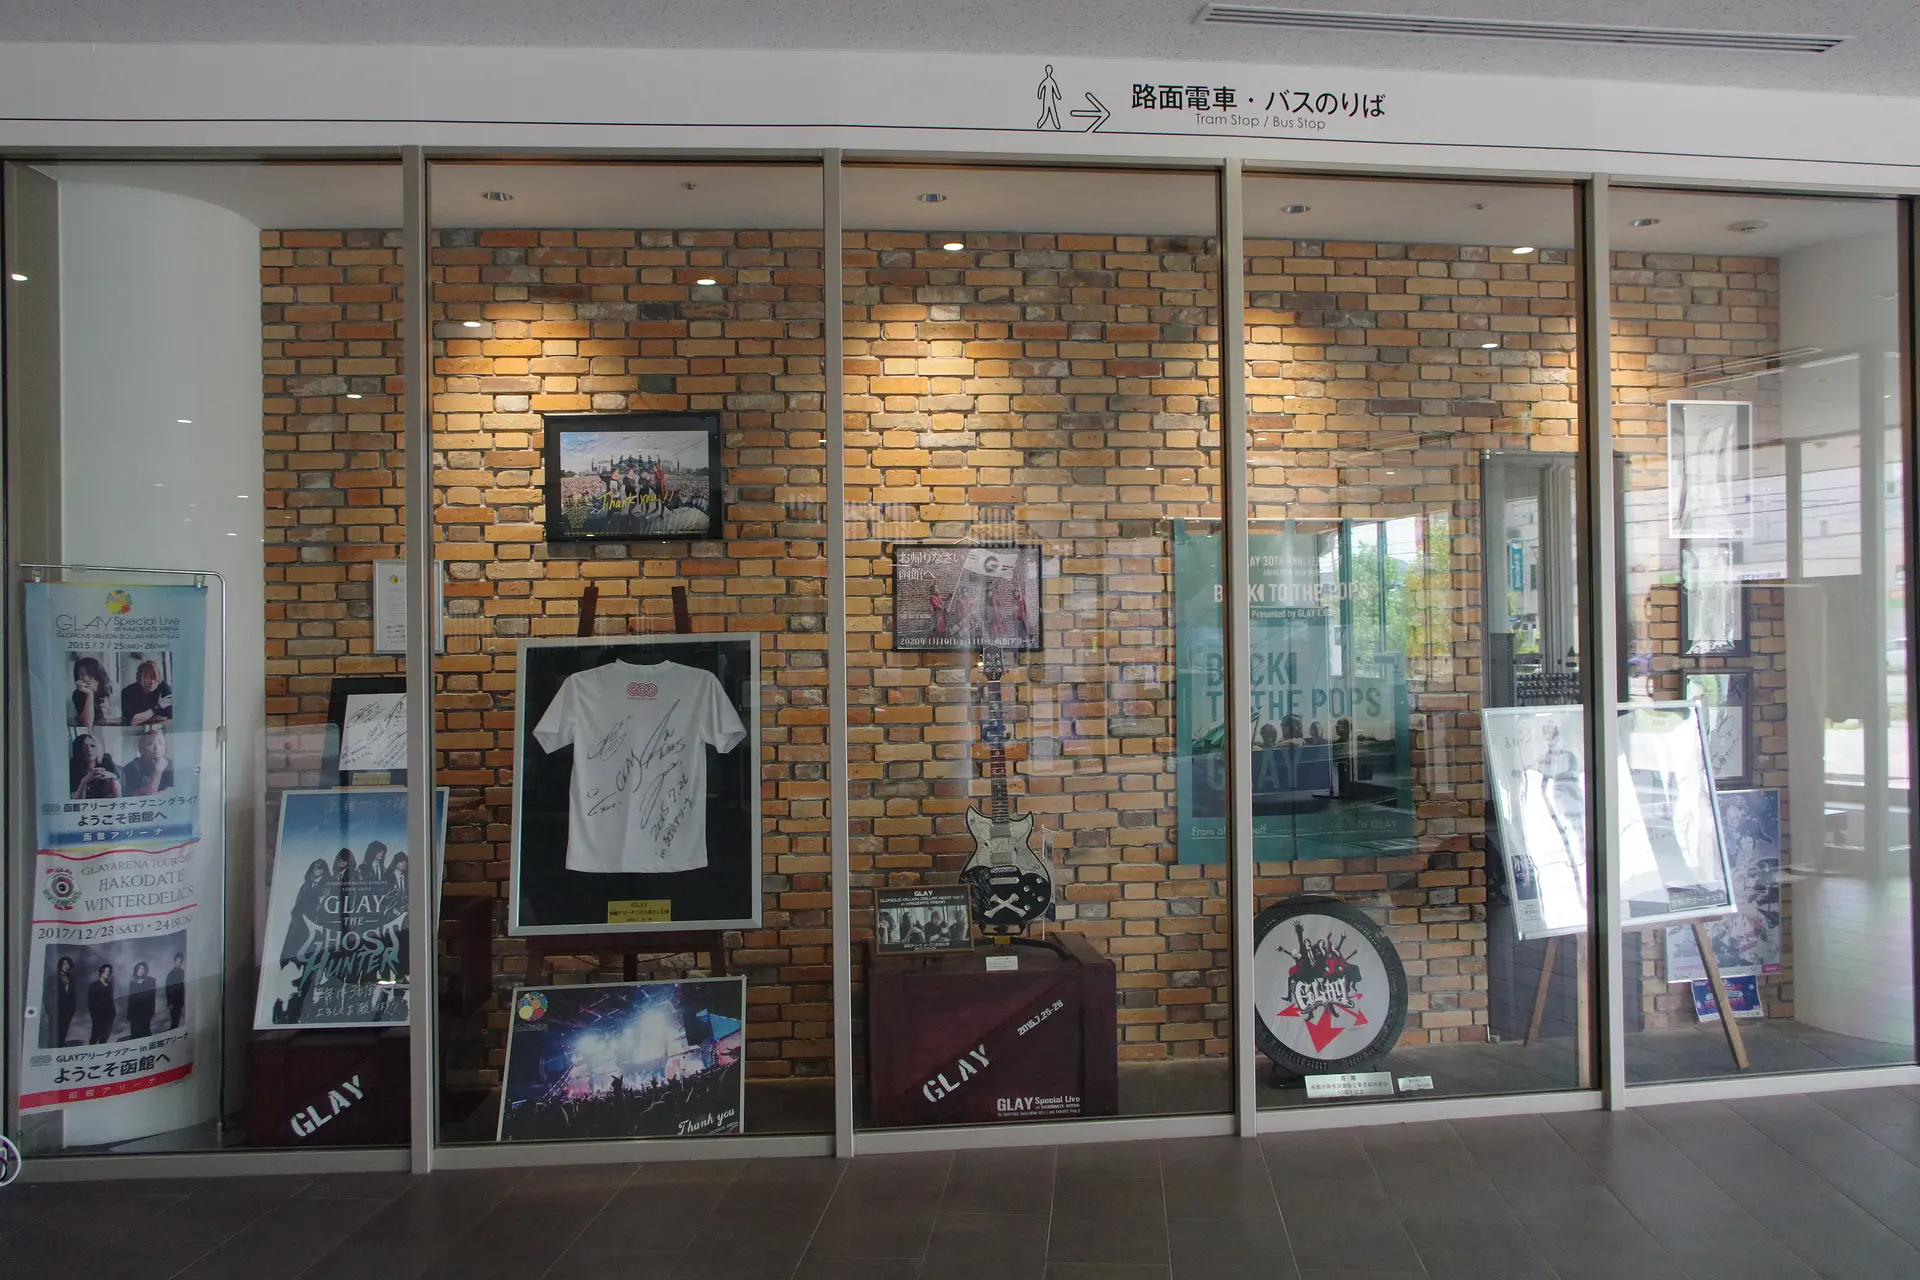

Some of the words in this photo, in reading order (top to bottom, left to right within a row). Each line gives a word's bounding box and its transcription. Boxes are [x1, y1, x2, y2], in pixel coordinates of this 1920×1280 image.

[1131, 83, 1387, 118] 路面電車・バスのりば
[1195, 113, 1228, 125] Tram
[1231, 114, 1260, 127] Stop
[1264, 116, 1270, 128] /
[1273, 116, 1295, 128] Bus
[1297, 117, 1327, 130] Stop
[595, 490, 636, 511] Thank
[898, 551, 966, 565] お帰りなさい
[1263, 556, 1285, 567] 30TH
[898, 567, 936, 581] 函館へ
[1268, 583, 1288, 603] TO
[1292, 583, 1322, 603] THE
[55, 614, 113, 631] GLAY
[113, 615, 157, 628] Special
[159, 615, 180, 626] Live
[1251, 609, 1286, 619] Presented
[1287, 609, 1296, 619] by
[1297, 608, 1316, 618] GLAY
[67, 641, 91, 650] 2015
[1311, 686, 1382, 720] POPS
[1207, 749, 1305, 791] GAY
[77, 811, 168, 827] ようこそ函館へ
[99, 868, 186, 892] HAKODATE
[84, 884, 195, 912] WINTERDELICS
[323, 894, 386, 915] GLAY
[344, 916, 364, 926] THE
[296, 911, 408, 963] GHOST
[300, 946, 400, 990] HUNTER
[56, 1045, 139, 1063] GLAYアリーナツアー
[139, 1044, 148, 1053] in
[53, 1053, 172, 1084] ようこそ函館へ
[922, 1044, 990, 1103] GLAY
[290, 1074, 364, 1137] GLAY
[996, 1096, 1034, 1112] GLAY
[1034, 1096, 1063, 1105] Special
[1065, 1095, 1081, 1103] Live
[677, 1111, 715, 1136] Thank
[716, 1108, 737, 1127] you
